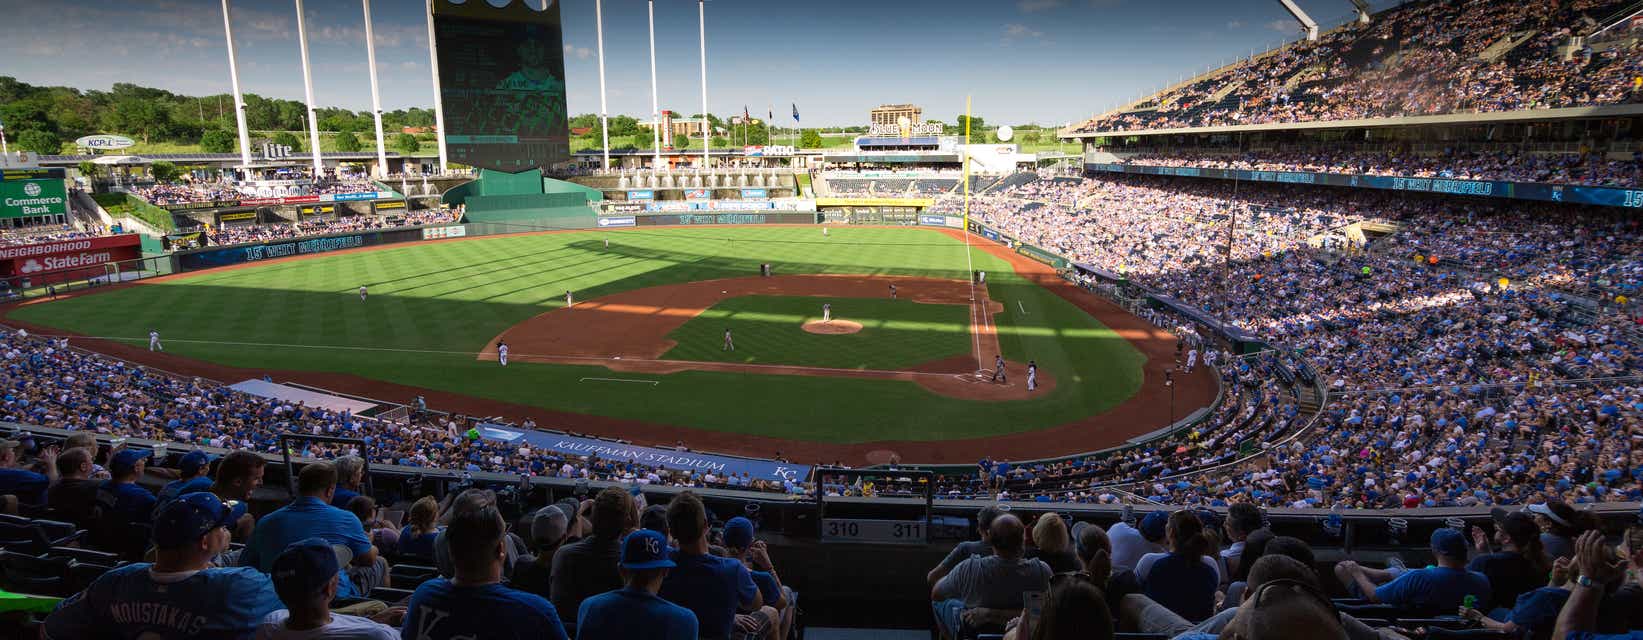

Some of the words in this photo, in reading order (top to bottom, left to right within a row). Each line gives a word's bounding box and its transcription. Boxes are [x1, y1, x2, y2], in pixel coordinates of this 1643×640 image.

[912, 122, 943, 133] MOON
[5, 197, 62, 206] Commerce
[1624, 190, 1643, 207] 15
[22, 205, 50, 214] Bank
[0, 240, 91, 259] NEIGHBORHOOD
[554, 440, 645, 459] KAUFFMAN
[645, 453, 726, 471] STADIUM
[773, 466, 797, 479] KC
[829, 522, 859, 536] 310
[893, 524, 920, 537] 311
[644, 536, 660, 554] KC
[111, 602, 207, 634] MOUSTAKAS
